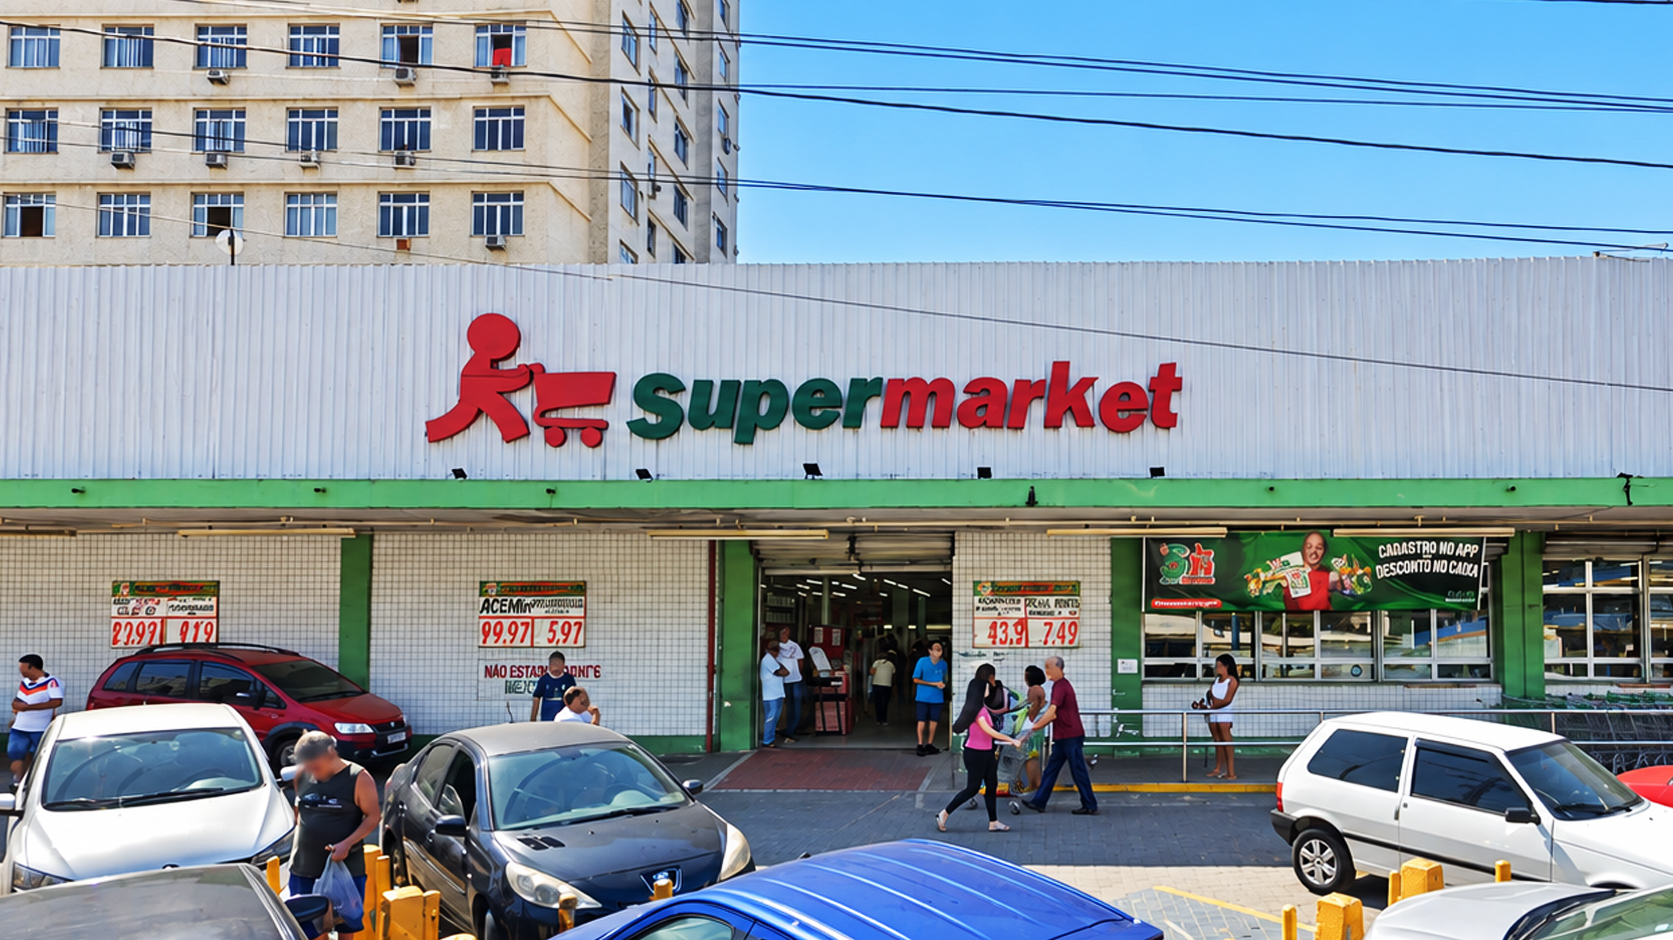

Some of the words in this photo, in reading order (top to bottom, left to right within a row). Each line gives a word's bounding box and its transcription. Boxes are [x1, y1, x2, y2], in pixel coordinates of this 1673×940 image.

[1439, 541, 1455, 555] NO
[1455, 543, 1479, 558] APP
[1375, 559, 1431, 579] DESCONTO
[1433, 559, 1448, 573] NO
[1043, 620, 1078, 646] 7.49
